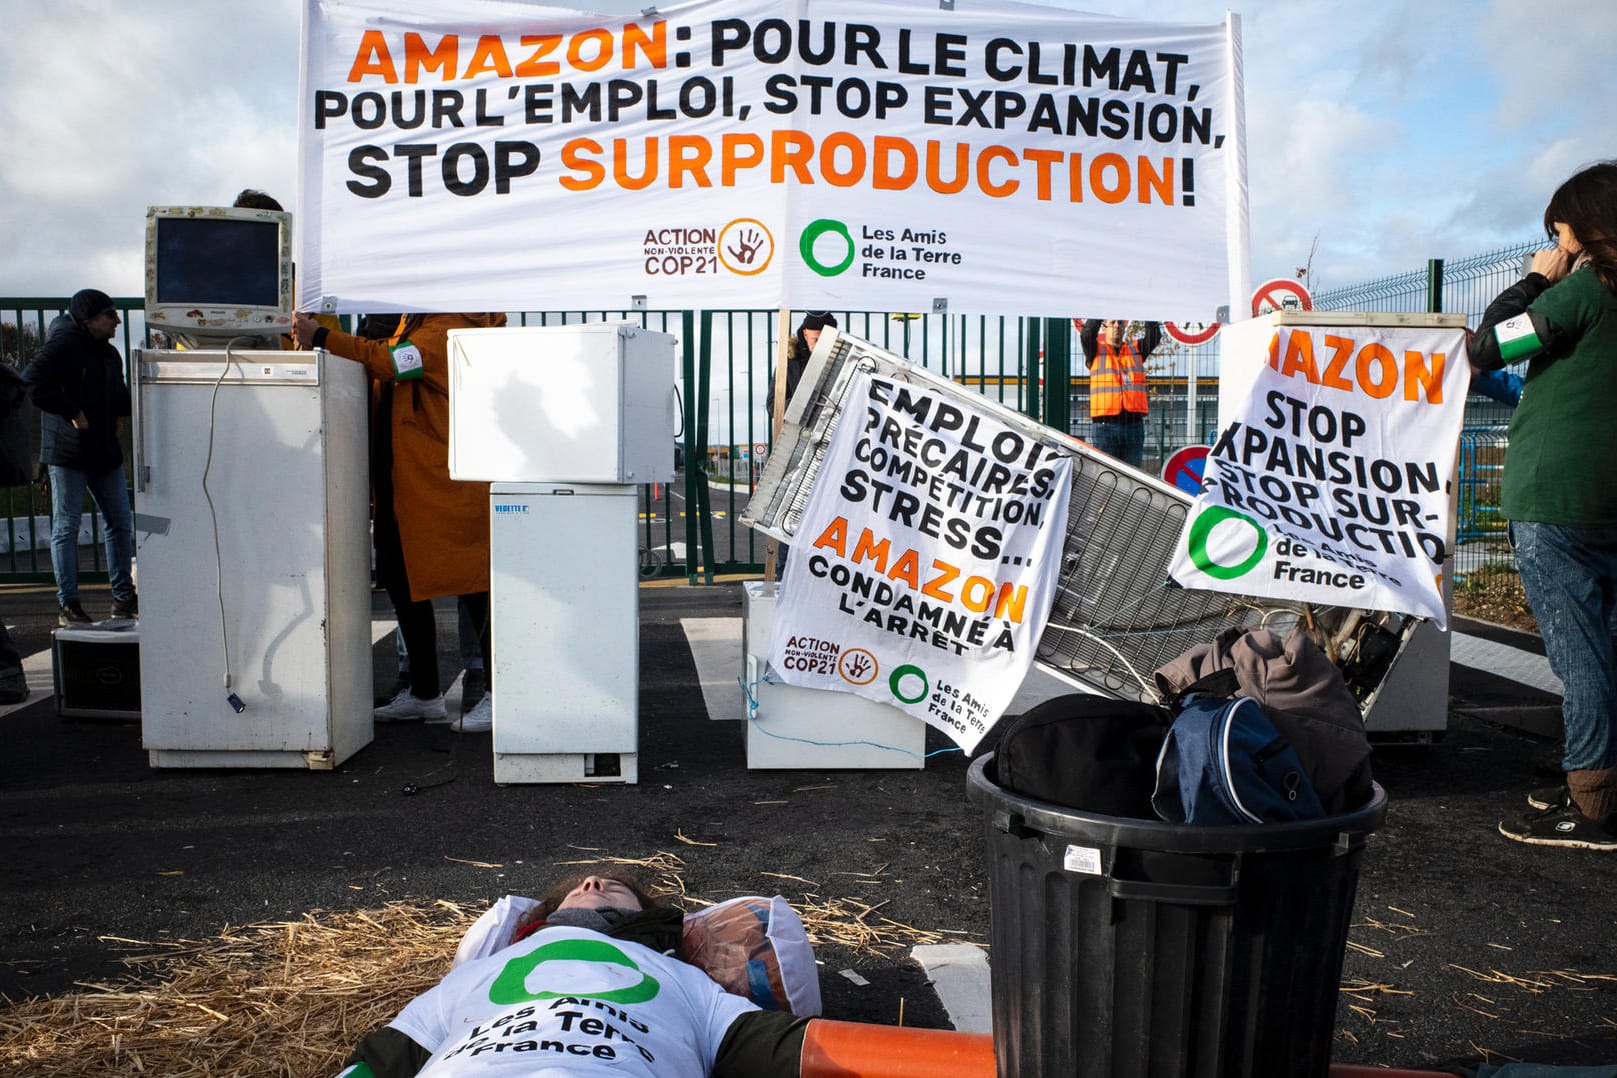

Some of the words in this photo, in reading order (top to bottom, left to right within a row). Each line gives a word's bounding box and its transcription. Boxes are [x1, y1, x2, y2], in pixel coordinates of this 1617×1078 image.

[711, 18, 887, 69] POUR
[898, 28, 967, 77] LE
[984, 38, 1201, 102] CLIMAT,
[314, 89, 465, 130] POUR
[475, 74, 751, 127] L'EMPLOI,
[764, 74, 908, 119] STOP
[924, 85, 1226, 150] EXPANSION,
[345, 140, 541, 198] STOP
[559, 130, 1195, 207] SURPRODUCTION!
[643, 228, 716, 246] ACTION
[644, 246, 716, 256] NON-VIOLENTE
[862, 225, 896, 242] Les
[900, 228, 947, 244] Amis
[645, 256, 718, 276] COP21
[861, 245, 884, 260] de
[890, 246, 907, 261] la
[912, 247, 962, 265] Terre
[862, 263, 927, 281] France
[1265, 390, 1366, 448] STOP
[865, 407, 1055, 500] PRÉCAIRES,
[855, 438, 1044, 530] COMPÉTITION,
[1214, 459, 1320, 509] STOP
[1332, 487, 1439, 530] SUR-
[840, 468, 1032, 567] STRESS...
[1276, 538, 1307, 557] de
[812, 515, 1029, 625] AMAZON
[1273, 561, 1365, 590] France
[808, 555, 989, 648] CONDAMNÉ
[997, 619, 1015, 653] À
[838, 592, 970, 657] L'ARRÊT
[785, 649, 838, 662] NON-VIOLENTE
[786, 636, 840, 654] ACTION
[783, 656, 837, 675] COP21
[932, 693, 946, 707] de
[950, 700, 963, 714] la
[966, 710, 986, 735] Terre
[936, 679, 960, 698] Les
[961, 692, 990, 718] Amis
[928, 702, 967, 734] France
[469, 1006, 535, 1040] Les
[548, 997, 650, 1034] Amis
[501, 1020, 538, 1037] la
[470, 1039, 617, 1061] France
